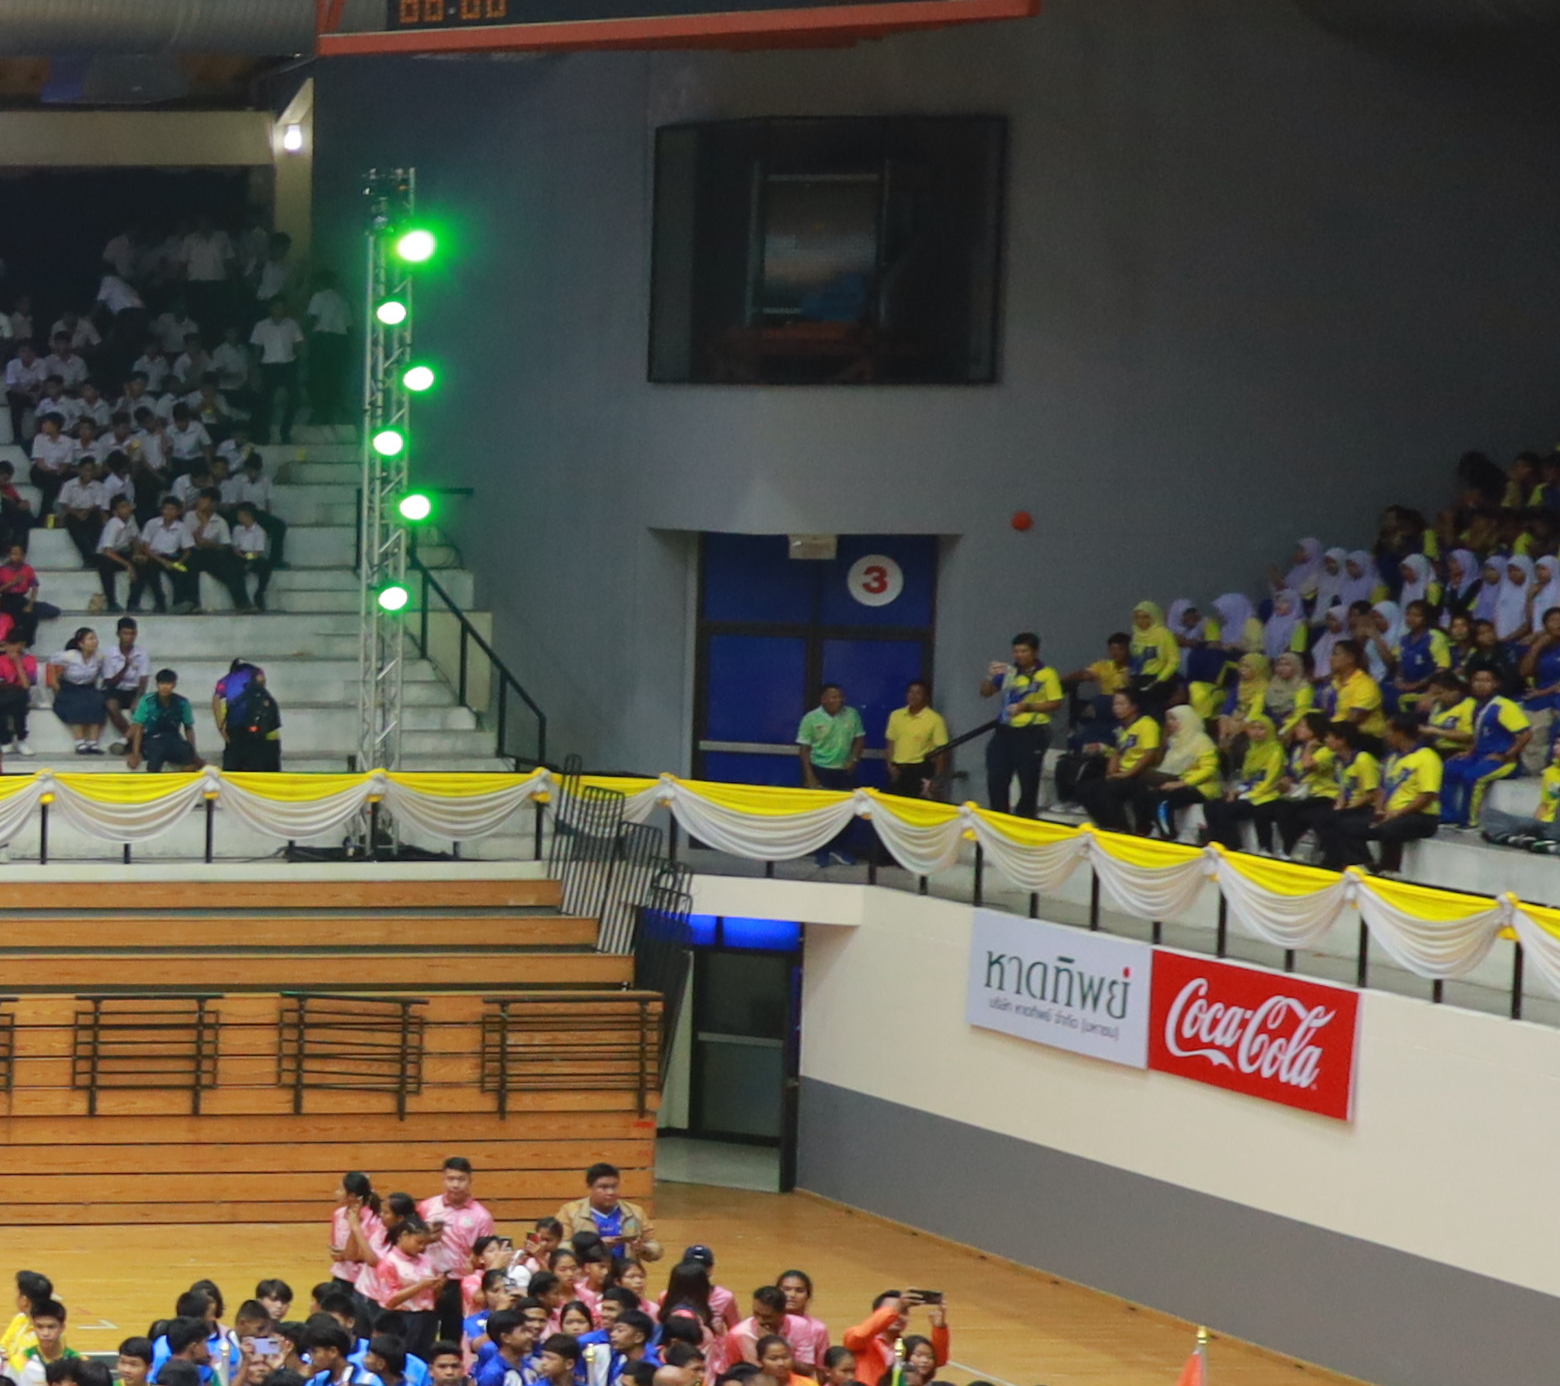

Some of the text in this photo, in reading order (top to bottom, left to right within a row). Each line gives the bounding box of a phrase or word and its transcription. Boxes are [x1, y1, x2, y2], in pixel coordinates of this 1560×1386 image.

[861, 565, 888, 594] 3
[984, 951, 1131, 1019] หาดทิพย์
[1164, 977, 1336, 1090] Coca-Cola
